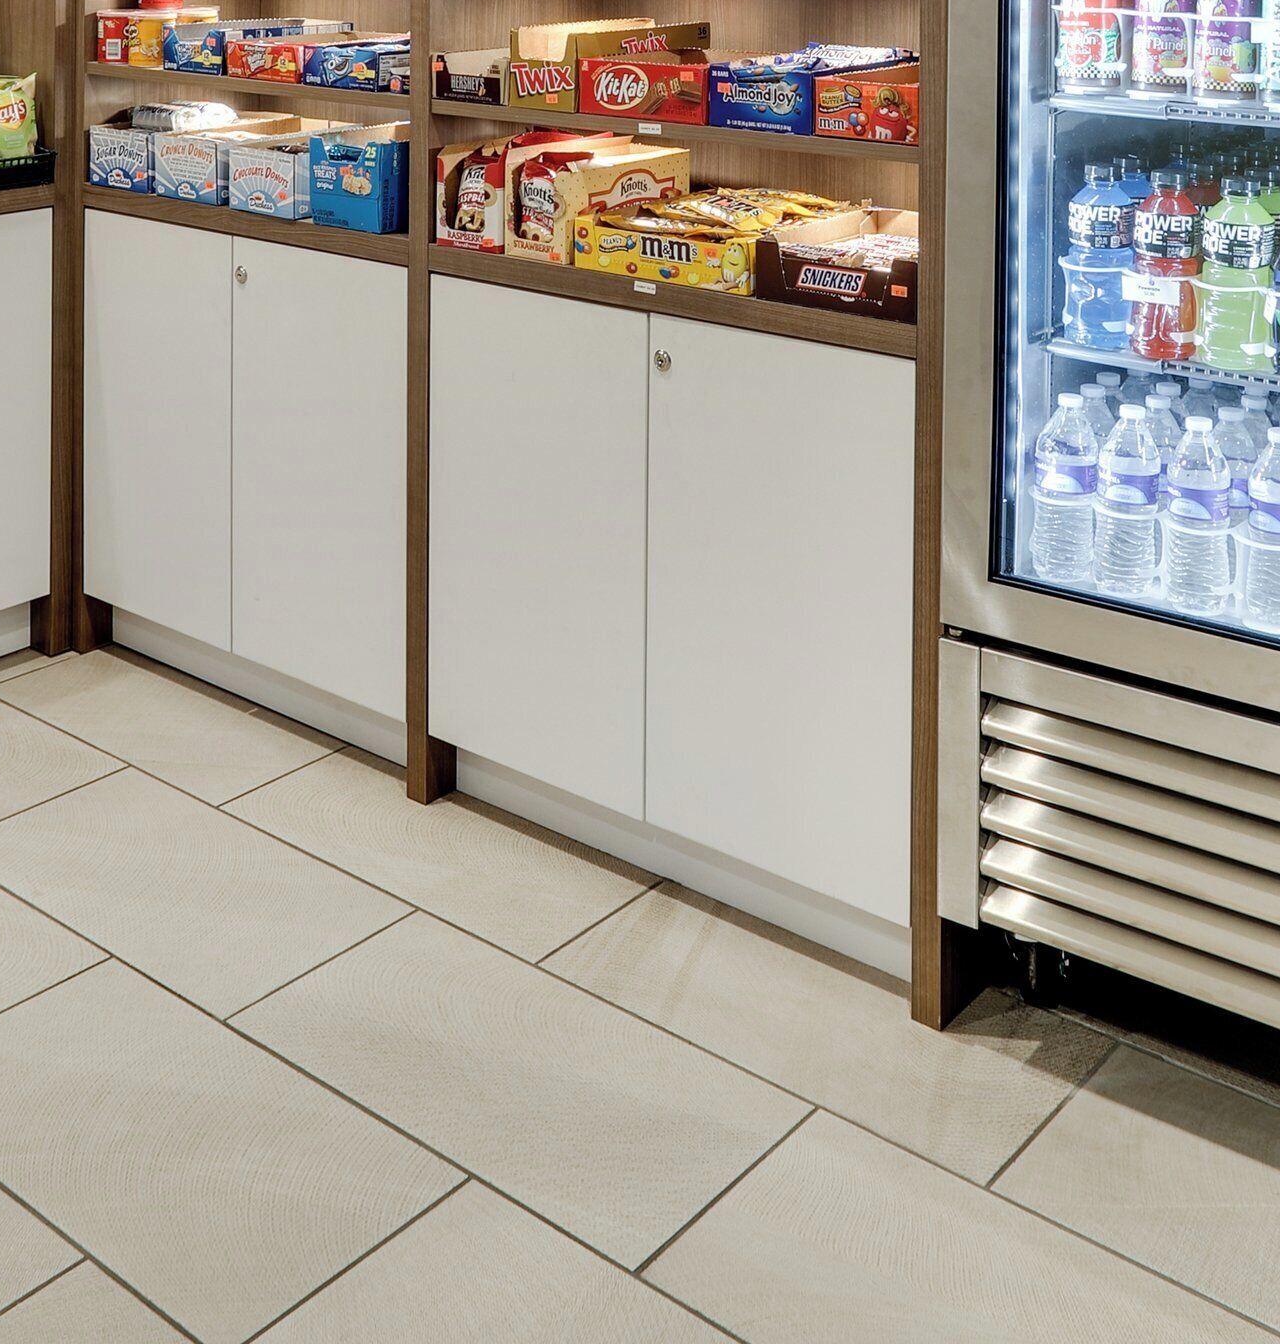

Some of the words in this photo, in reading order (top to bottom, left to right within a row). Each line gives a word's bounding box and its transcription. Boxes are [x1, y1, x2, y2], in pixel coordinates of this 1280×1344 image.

[697, 27, 707, 36] 36
[451, 75, 485, 90] HERSHEY'S
[723, 83, 771, 101] Almond
[772, 86, 795, 106] Joy
[96, 145, 117, 162] SUGAR
[119, 145, 144, 165] DONUTS
[160, 144, 186, 158] CRUNCH
[187, 145, 213, 165] DONUTS
[364, 146, 376, 158] 25
[232, 167, 264, 182] CHOCOLATE
[265, 167, 289, 189] DONUTS
[313, 169, 337, 181] TREATS
[523, 183, 554, 203] Knott's
[620, 177, 648, 196] Knott's
[249, 197, 274, 211] Duchess
[1134, 211, 1193, 232] POWER
[447, 230, 484, 242] RASPBERRY
[513, 239, 555, 253] STRAWBERRY
[800, 269, 862, 292] SNICKERS
